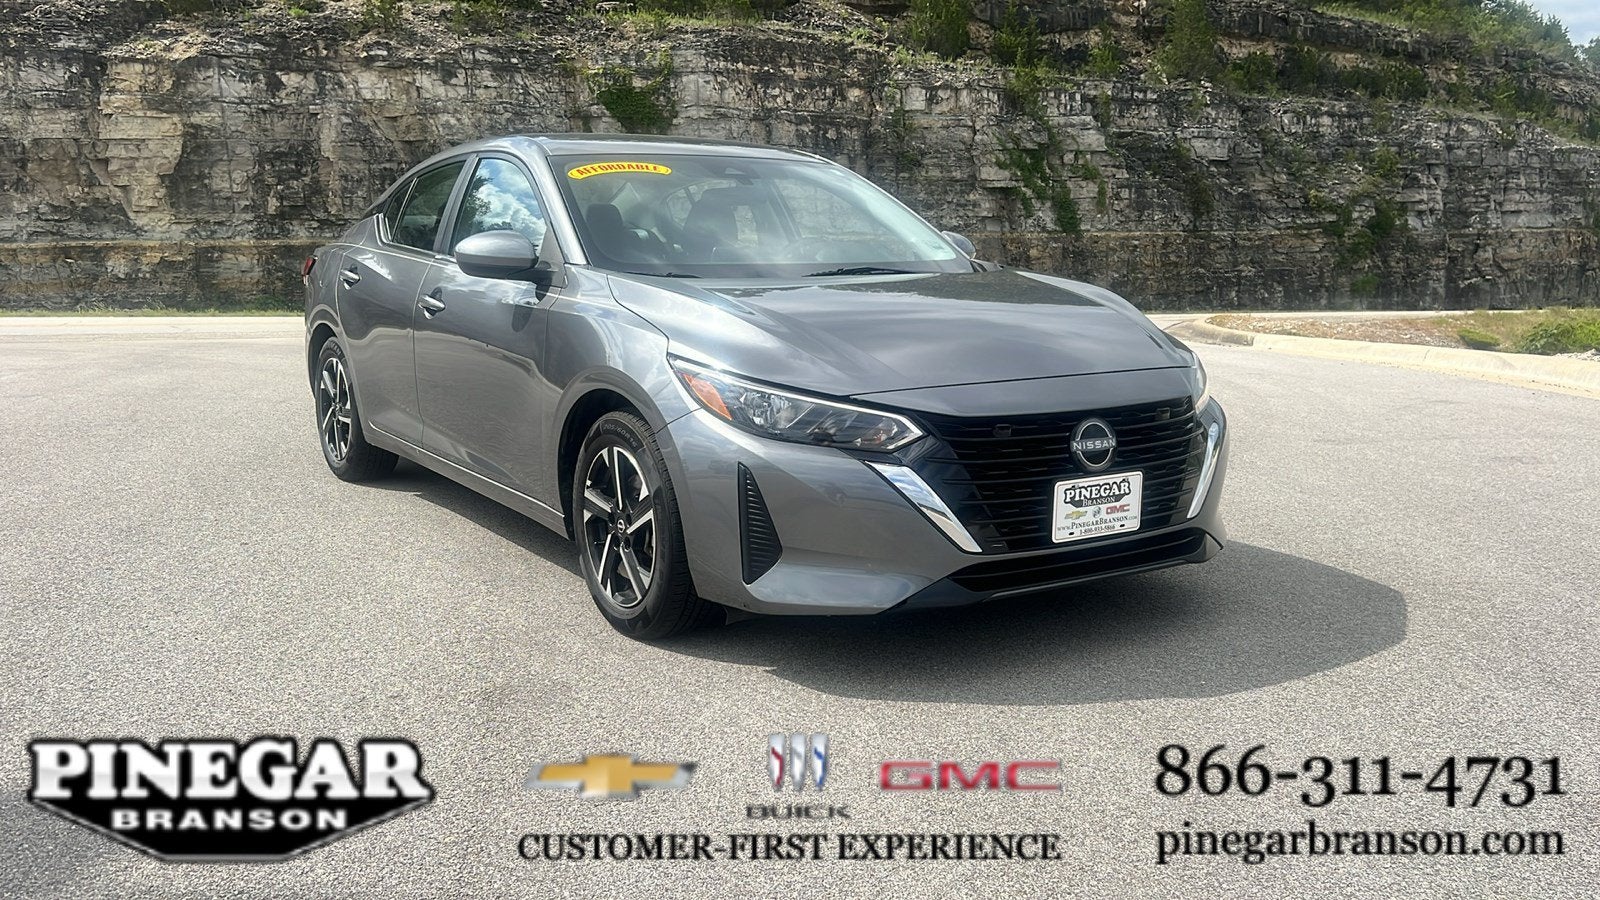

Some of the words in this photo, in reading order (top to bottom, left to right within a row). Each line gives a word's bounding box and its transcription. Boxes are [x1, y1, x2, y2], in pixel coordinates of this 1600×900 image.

[575, 163, 661, 176] AFFORDABLE
[1072, 438, 1116, 450] NISSAN
[1065, 481, 1130, 502] PINEGAR
[1105, 504, 1130, 515] GMC
